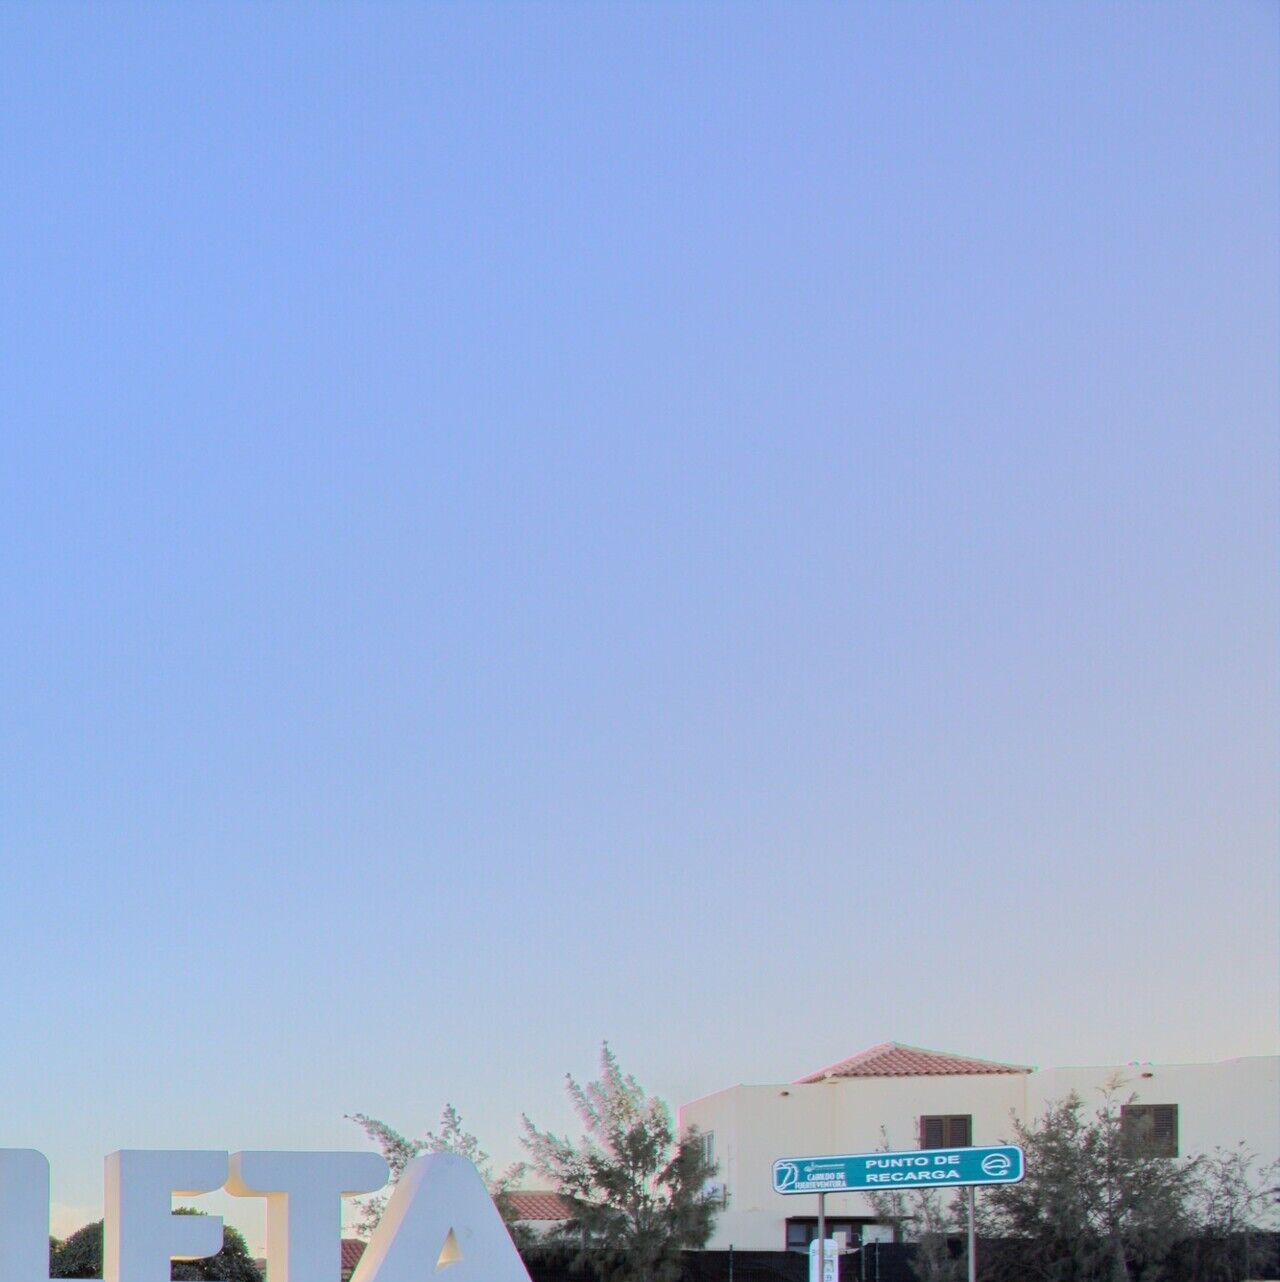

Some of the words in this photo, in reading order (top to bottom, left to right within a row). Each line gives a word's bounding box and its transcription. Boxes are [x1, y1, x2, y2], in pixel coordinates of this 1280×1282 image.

[865, 1157, 929, 1169] PUNTO
[934, 1155, 960, 1165] DE
[865, 1169, 960, 1183] RECARGA
